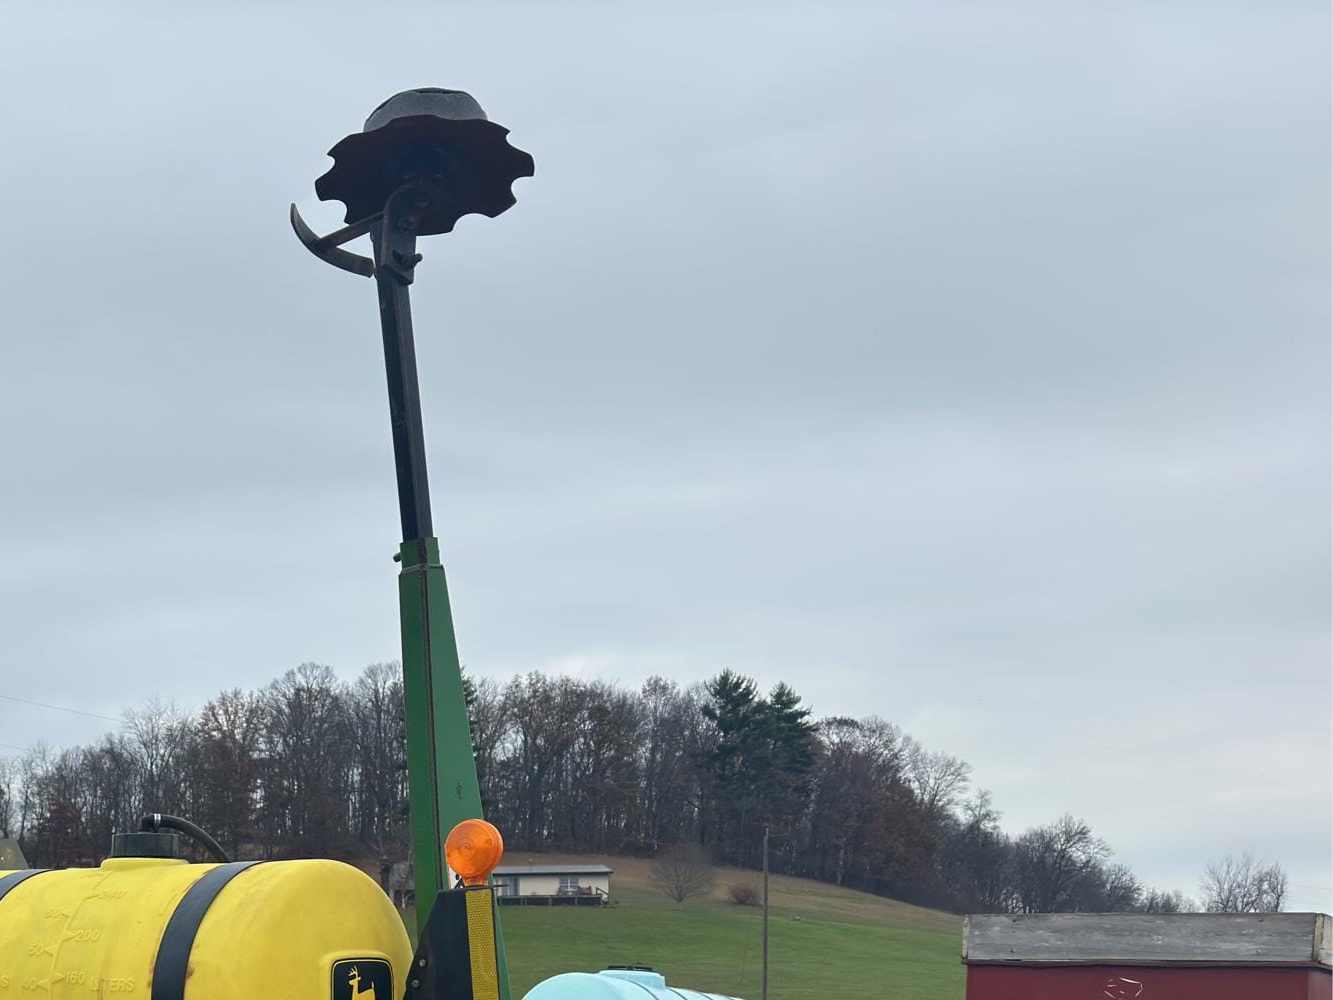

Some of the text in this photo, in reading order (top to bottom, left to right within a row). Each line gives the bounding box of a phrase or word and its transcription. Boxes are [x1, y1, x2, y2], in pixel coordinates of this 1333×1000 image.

[76, 929, 100, 942] 200
[29, 944, 44, 956] 50
[21, 976, 37, 990] 40
[65, 970, 86, 985] 160
